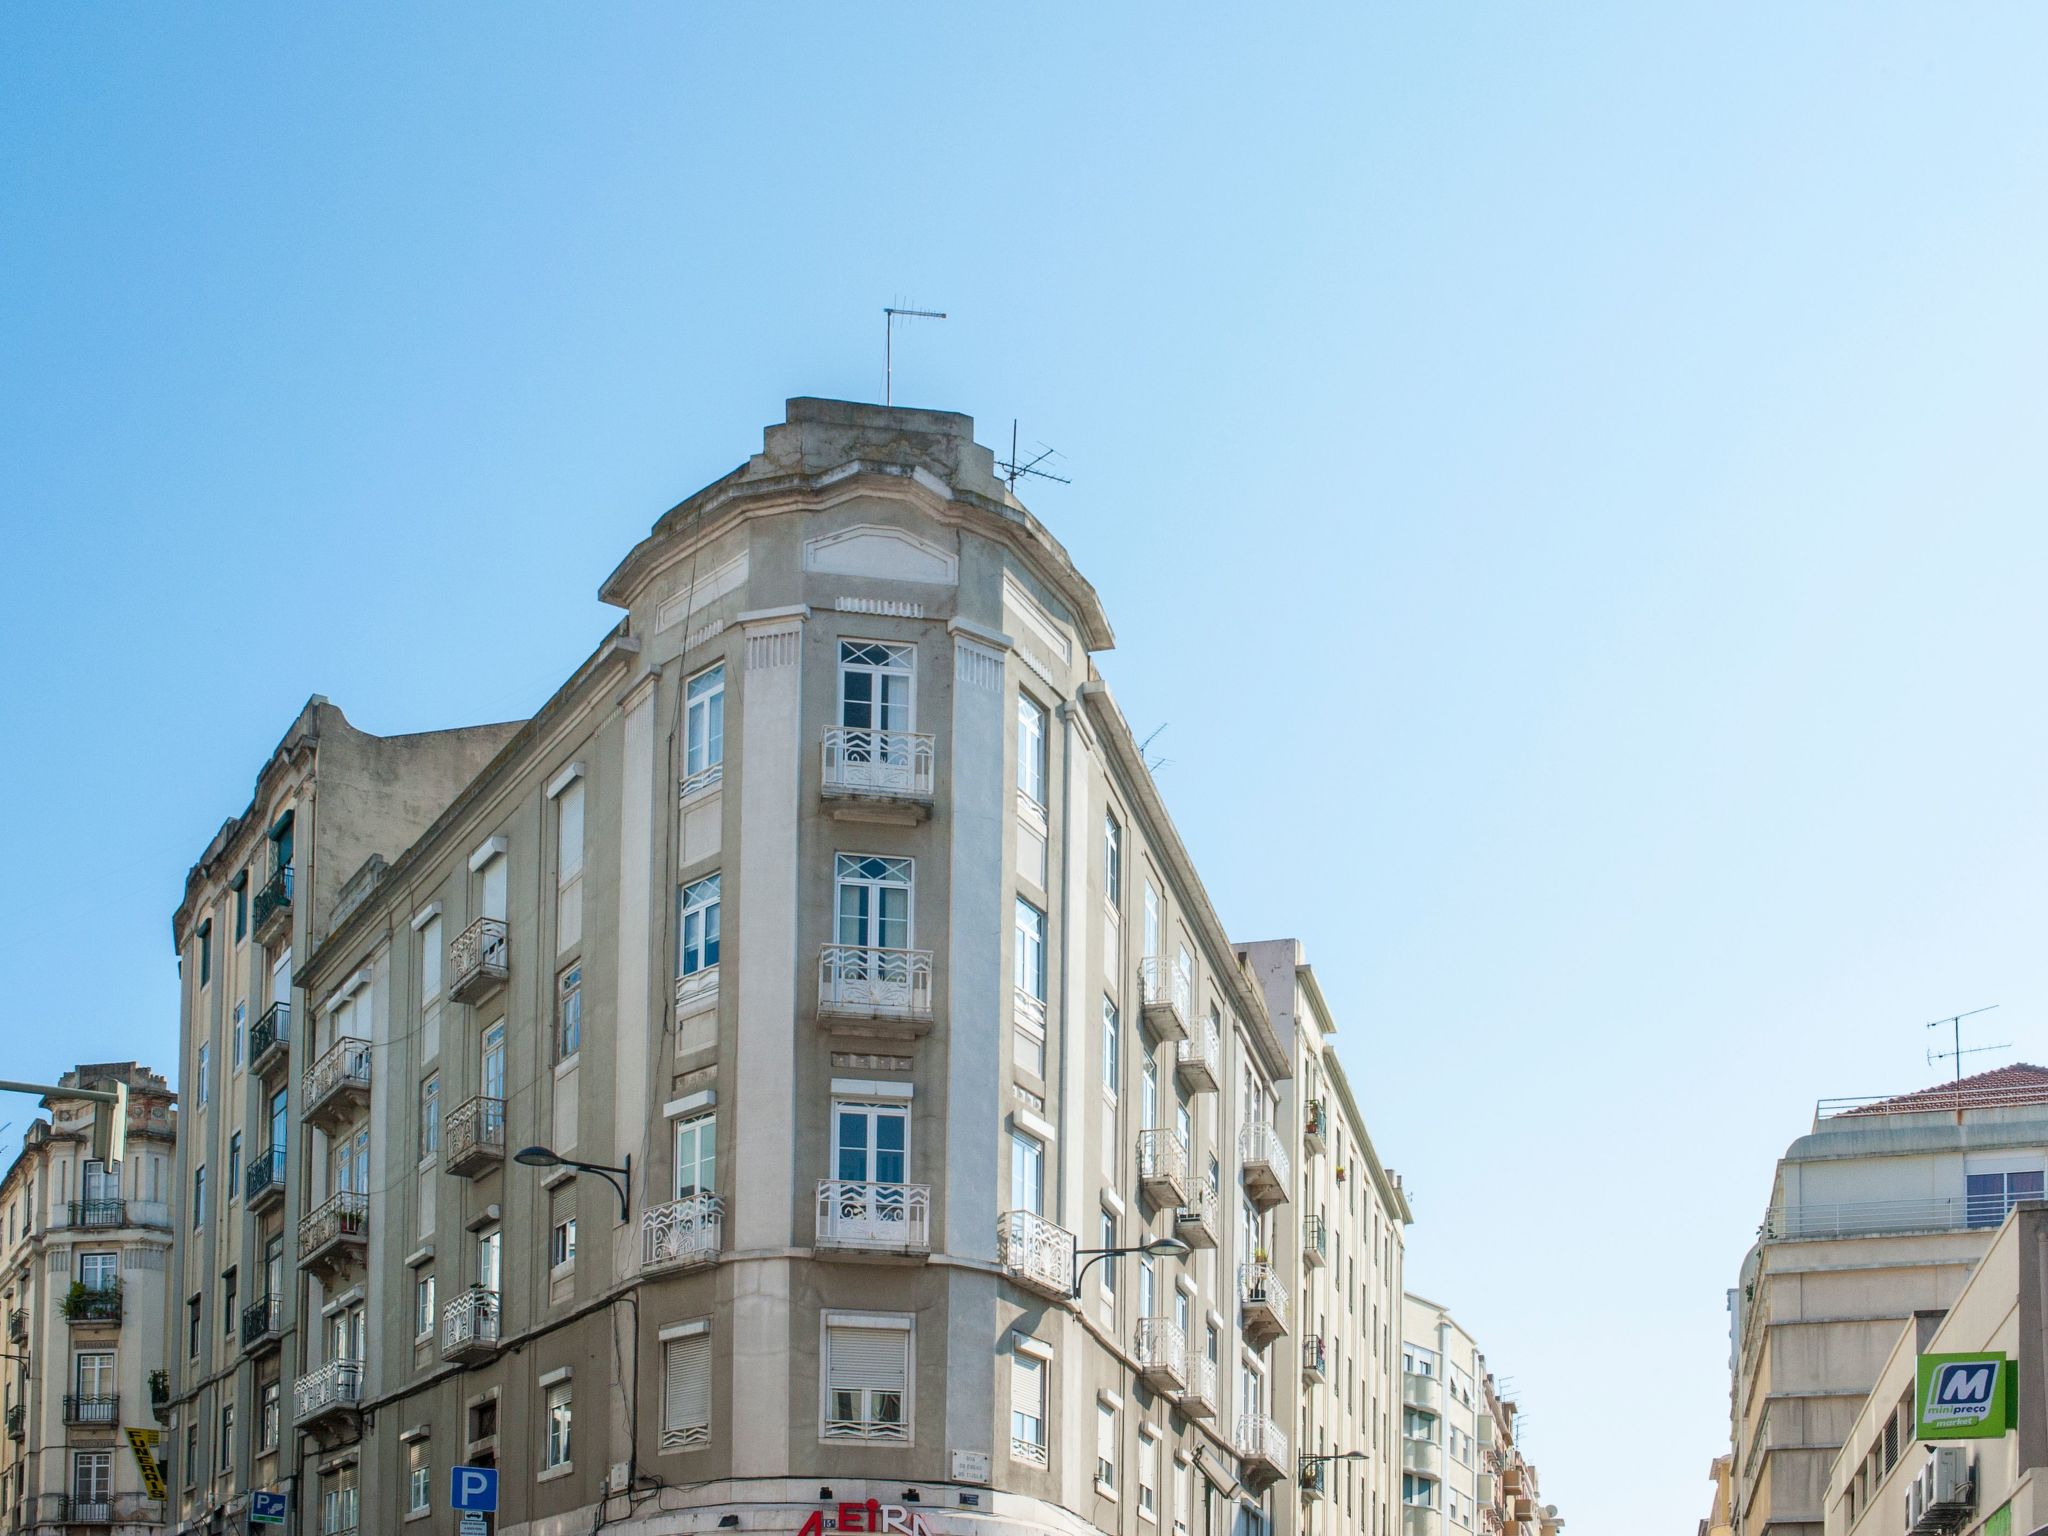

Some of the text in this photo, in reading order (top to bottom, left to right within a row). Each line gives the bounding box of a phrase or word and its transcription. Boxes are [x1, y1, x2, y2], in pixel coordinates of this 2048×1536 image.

[1943, 1369, 1989, 1401] M
[1928, 1404, 1986, 1415] minipreço
[1936, 1418, 1973, 1428] market
[127, 1430, 165, 1498] FUNERAIS
[461, 1471, 488, 1506] P
[257, 1494, 270, 1509] P
